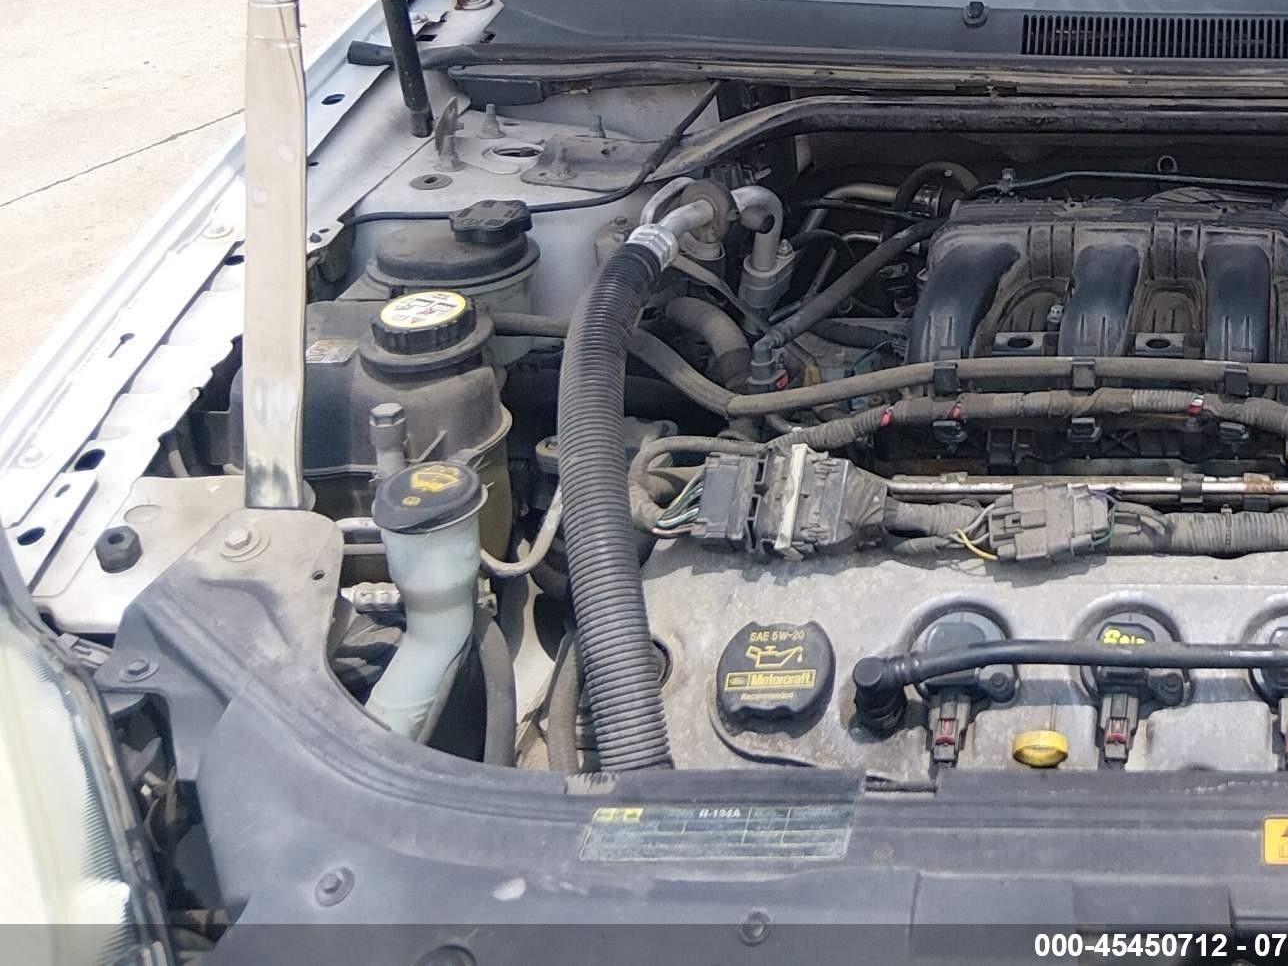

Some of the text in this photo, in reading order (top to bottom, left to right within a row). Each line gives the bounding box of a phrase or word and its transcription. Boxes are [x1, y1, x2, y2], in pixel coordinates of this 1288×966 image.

[749, 629, 805, 643] SAE 5W-20
[750, 672, 812, 687] Motorcraft
